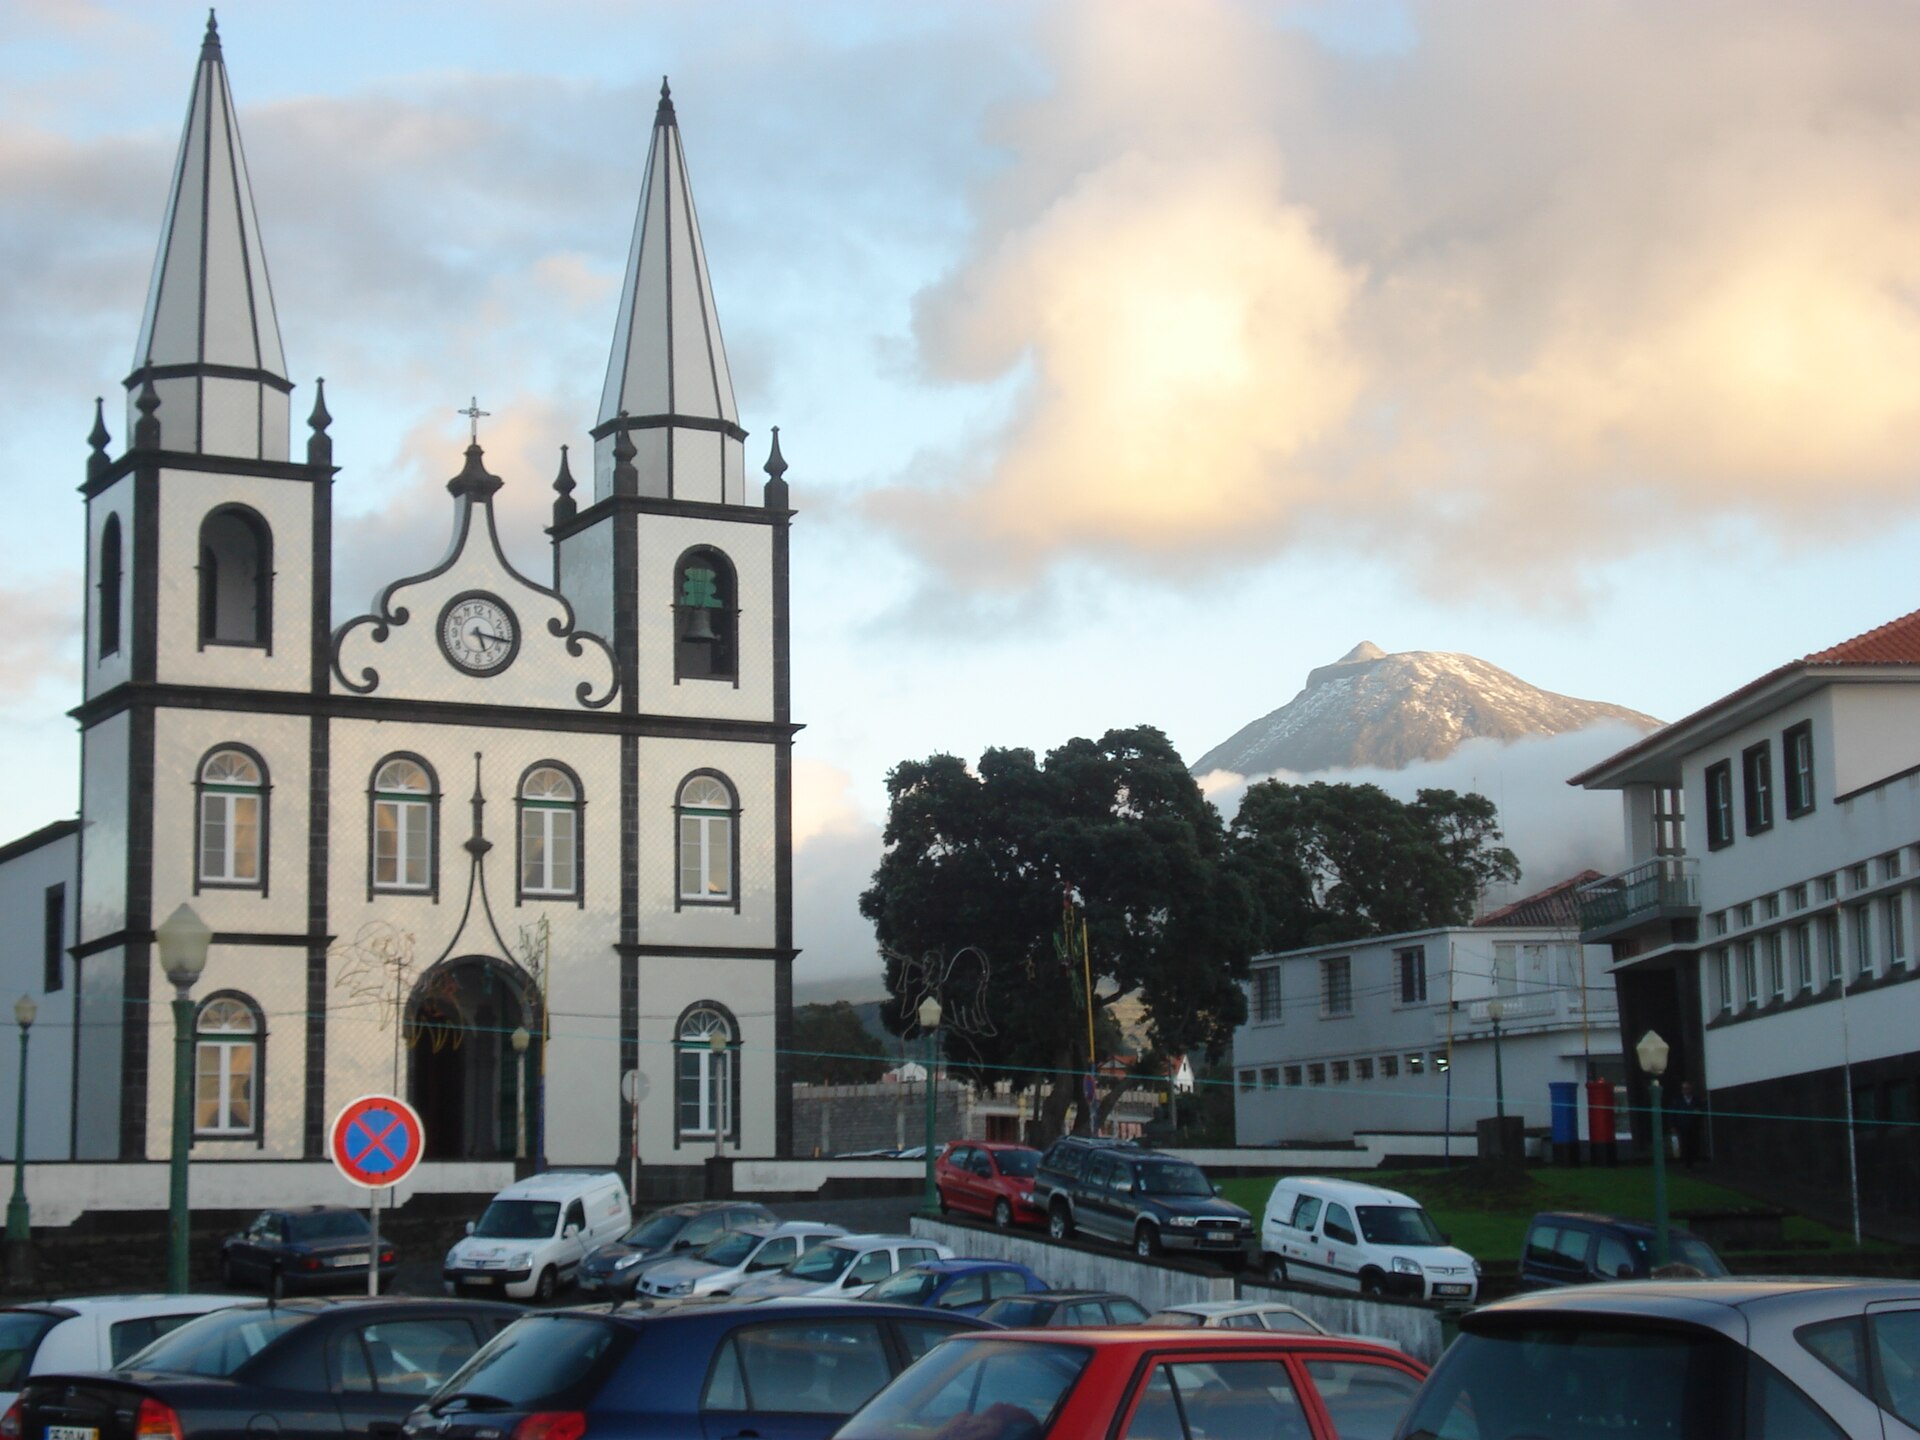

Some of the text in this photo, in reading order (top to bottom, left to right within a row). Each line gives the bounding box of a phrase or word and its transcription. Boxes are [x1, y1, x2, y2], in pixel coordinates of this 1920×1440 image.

[474, 605, 484, 616] 12
[496, 619, 502, 630] 2
[451, 627, 458, 638] 9
[455, 640, 461, 650] 8
[464, 650, 469, 661] 7
[475, 653, 481, 664] 6
[487, 651, 493, 662] 5
